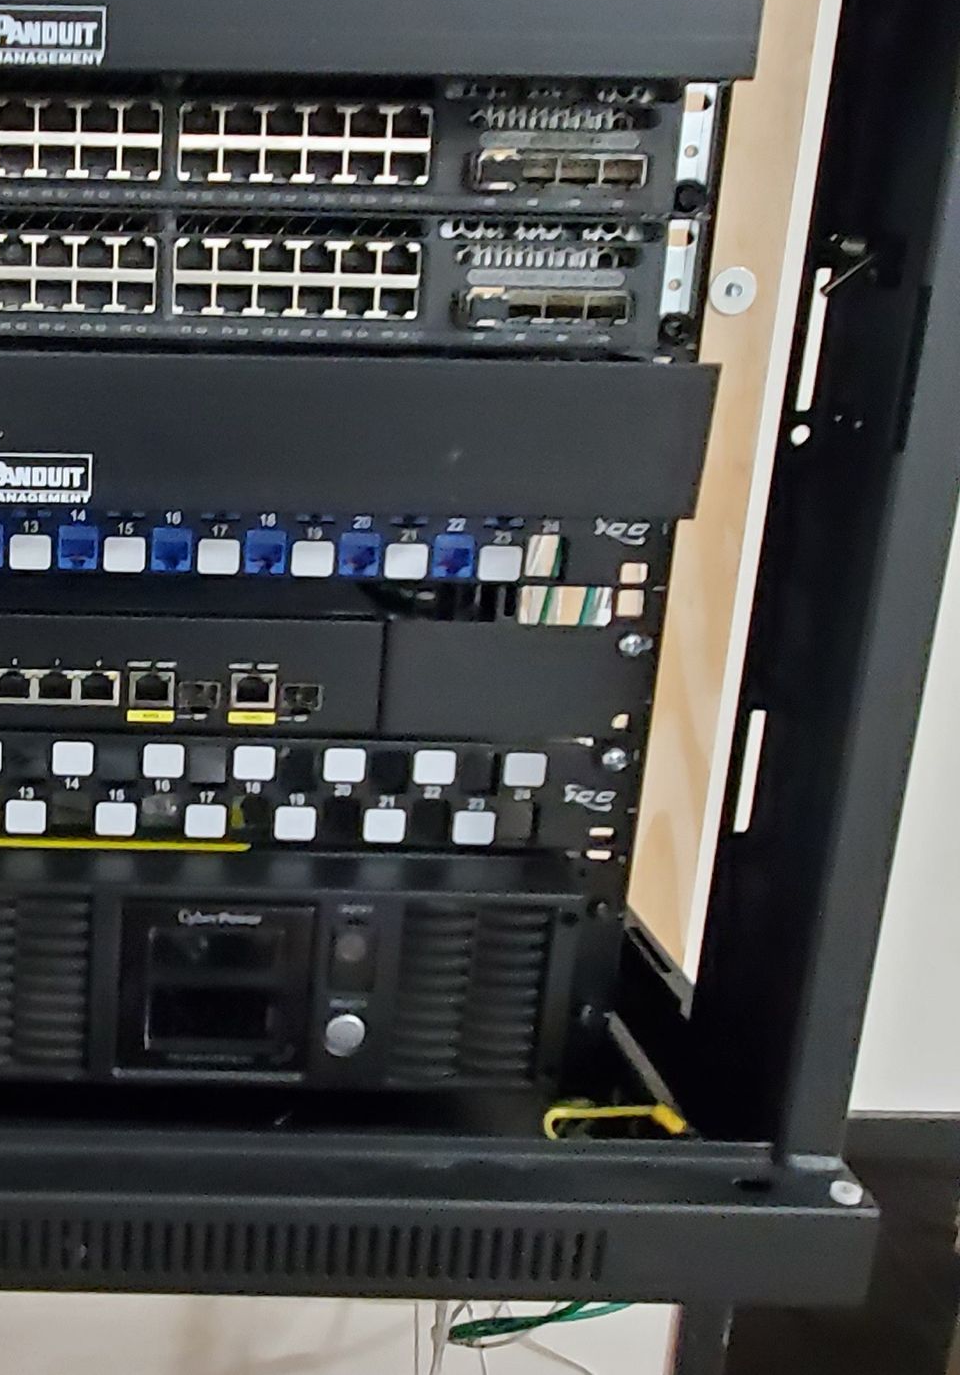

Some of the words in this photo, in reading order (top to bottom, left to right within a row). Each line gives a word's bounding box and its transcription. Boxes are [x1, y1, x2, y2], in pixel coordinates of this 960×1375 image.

[70, 509, 86, 522] 14
[165, 511, 182, 525] 16
[260, 512, 276, 527] 18
[352, 515, 372, 529] 20
[23, 520, 39, 533] 13
[118, 522, 134, 535] 15
[211, 524, 228, 537] 17
[307, 527, 323, 540] 19
[64, 777, 80, 790] 14
[155, 779, 171, 792] 16
[245, 781, 261, 795] 18
[18, 786, 35, 799] 13
[108, 788, 125, 802] 15
[198, 790, 215, 803] 17
